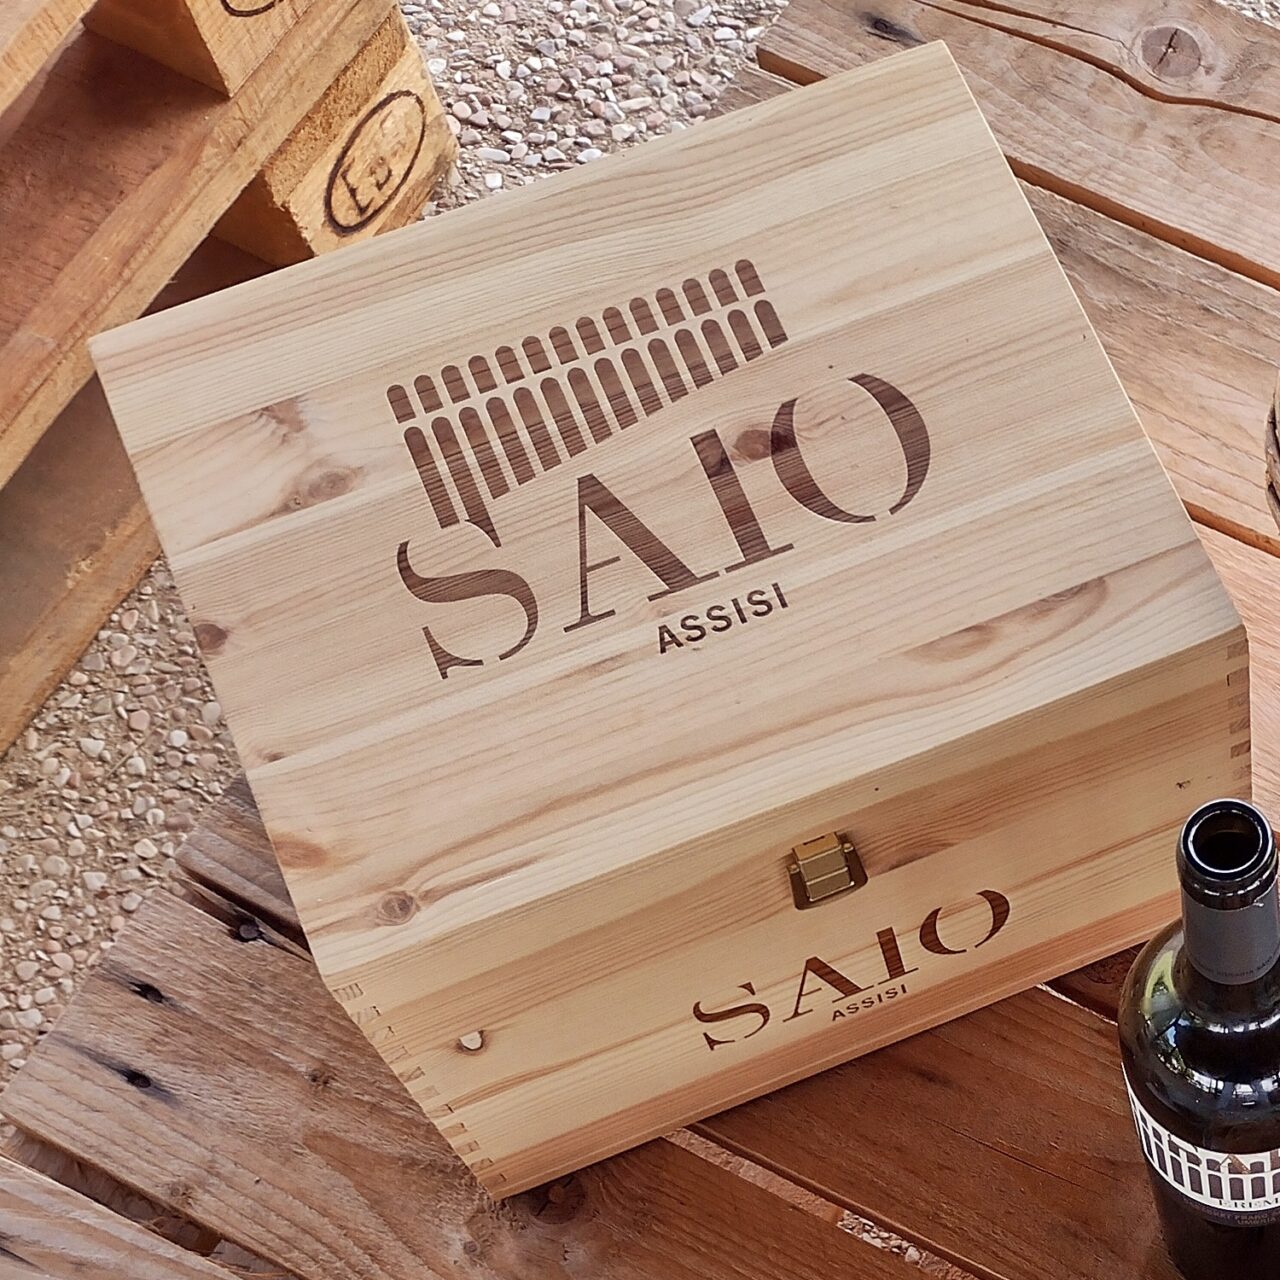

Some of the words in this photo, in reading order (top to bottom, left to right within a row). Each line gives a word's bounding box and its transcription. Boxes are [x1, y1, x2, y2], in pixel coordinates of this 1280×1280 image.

[396, 372, 932, 681] SAIO
[657, 582, 789, 655] ASSISI
[692, 889, 1011, 1052] SAIO
[831, 983, 909, 1022] ASSISI
